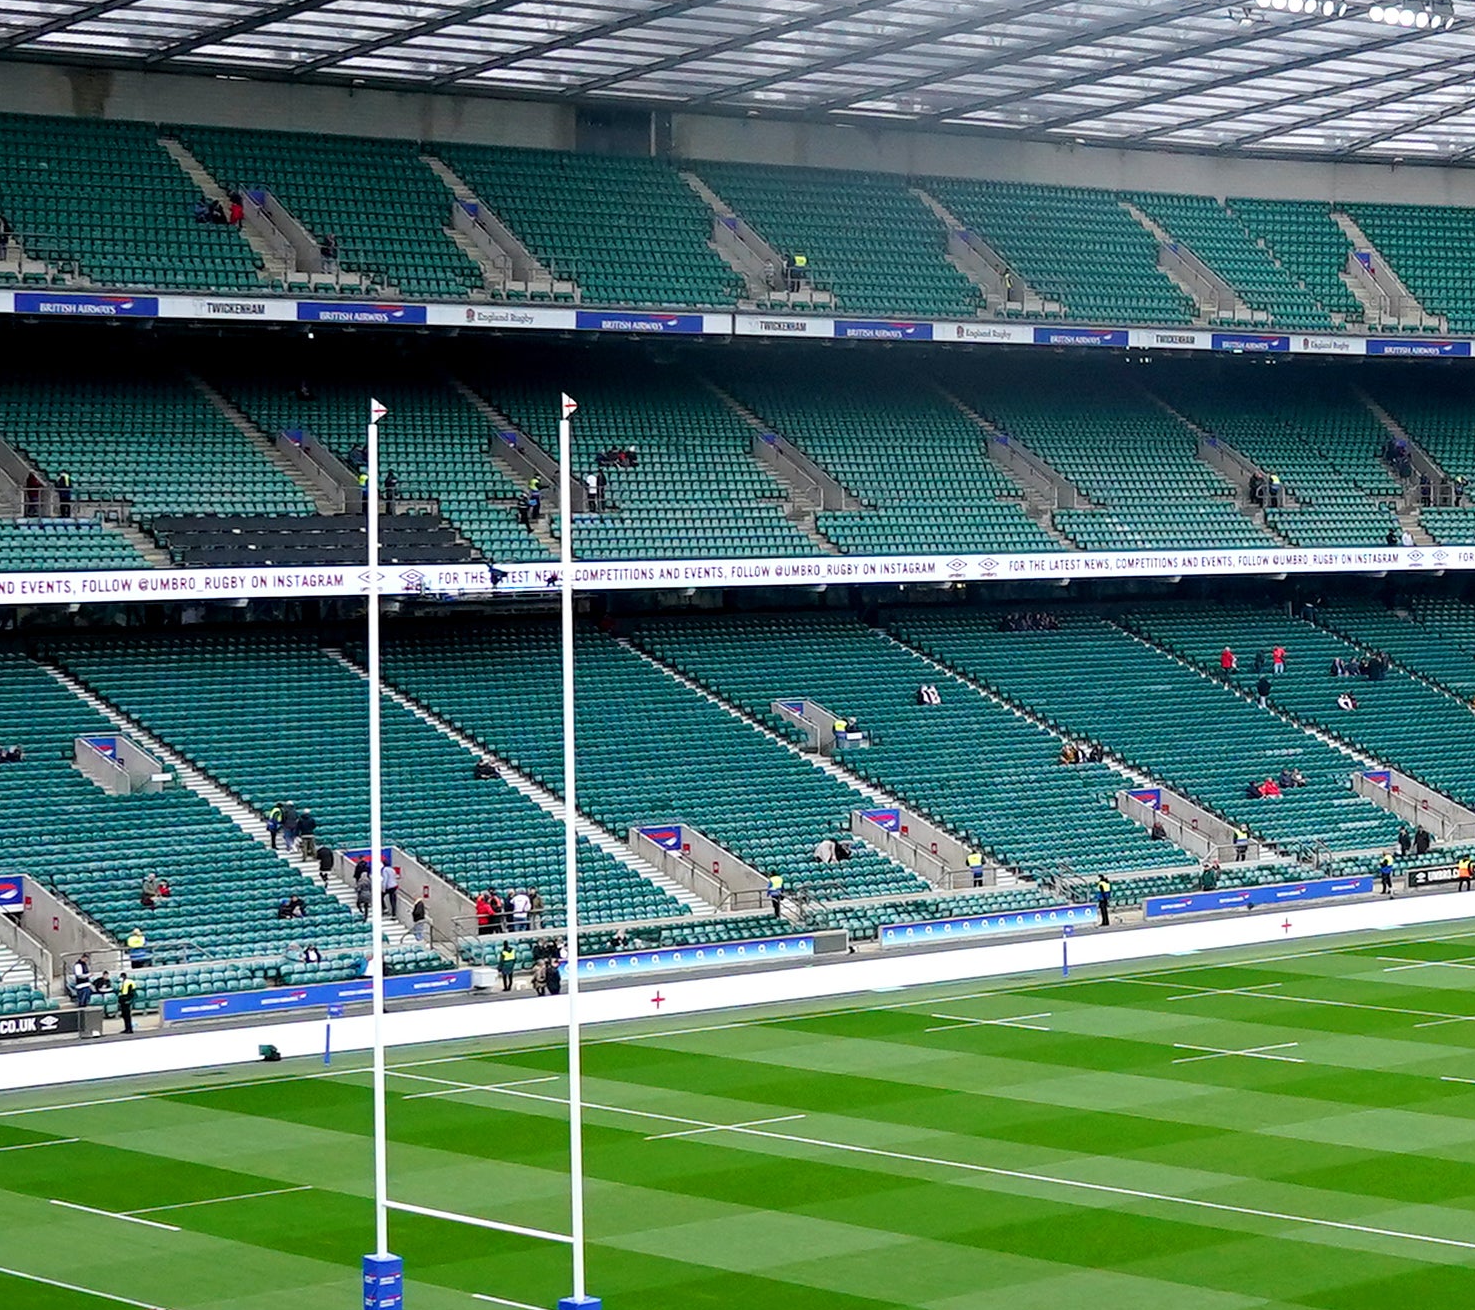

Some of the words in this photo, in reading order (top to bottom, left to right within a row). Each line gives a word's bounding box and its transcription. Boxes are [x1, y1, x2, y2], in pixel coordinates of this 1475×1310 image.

[40, 303, 76, 312] BRITISH
[75, 305, 116, 314] AIRWAYS
[207, 303, 265, 314] TWICKENHAM
[320, 312, 352, 320] BRITISH
[438, 571, 461, 585] FOR
[465, 571, 485, 584] THE
[575, 568, 655, 582] COMPETITIONS
[659, 568, 679, 579] AND
[685, 567, 726, 579] EVENTS,
[732, 566, 770, 578] FOLLOW
[775, 565, 859, 578] @UMBRO_RUGBY
[863, 564, 876, 575] ON
[880, 563, 936, 575] INSTAGRAM
[21, 580, 75, 594] EVENTS,
[82, 579, 132, 592] FOLLOW
[138, 576, 245, 592] @UMBRO_RUGBY
[252, 576, 267, 588] ON
[274, 574, 343, 588] INSTAGRAM
